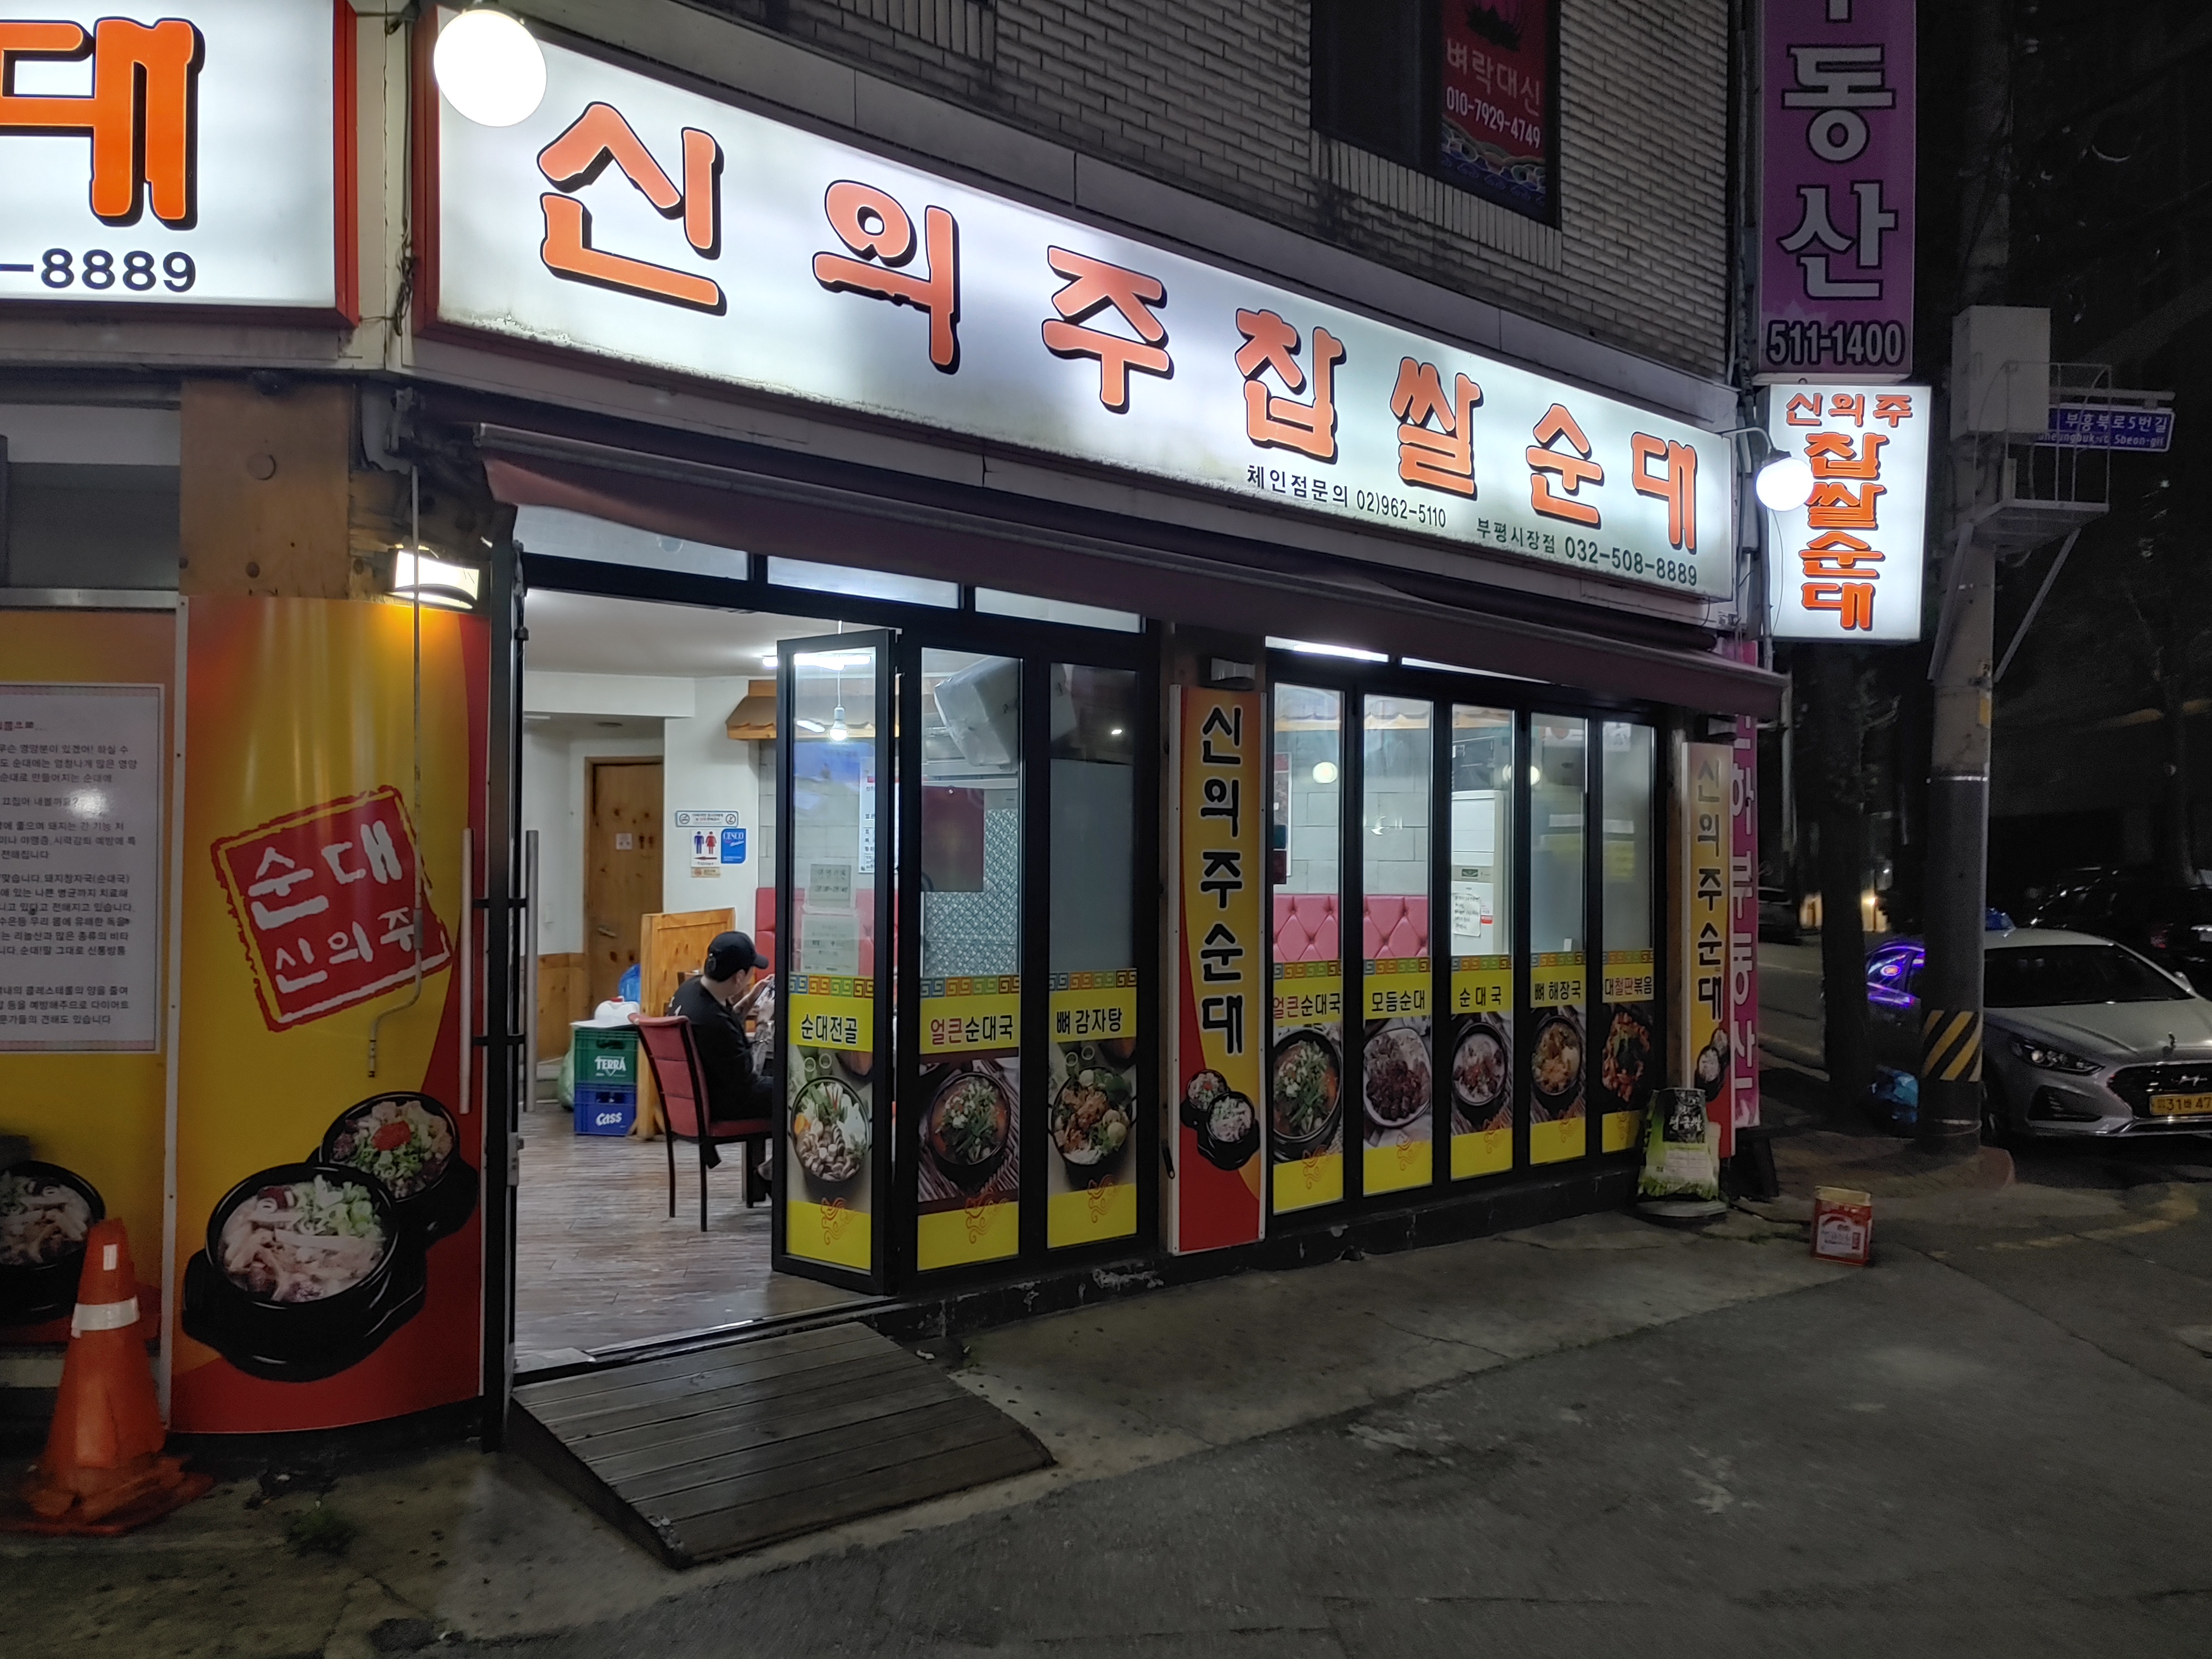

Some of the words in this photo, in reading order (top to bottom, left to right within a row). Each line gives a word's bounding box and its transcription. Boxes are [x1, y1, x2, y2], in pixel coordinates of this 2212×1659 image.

[1446, 86, 1541, 149] 010-7929-4749
[1776, 0, 1899, 301] 동산
[1766, 320, 1904, 366] 511-1400
[1786, 392, 1914, 427] 신의주
[2066, 413, 2168, 433] 부흥북로5번길
[1247, 464, 1348, 508] 체인점문의
[1356, 489, 1447, 529] 02)962-5110
[1798, 431, 1891, 631] 찹쌀순대
[1476, 517, 1556, 555] 부평시장점
[1564, 535, 1697, 587] 032-508-8889
[120, 745, 128, 754] 수
[93, 822, 111, 832] 기능
[247, 820, 403, 930] 순대
[1199, 706, 1244, 1056] 신의주순대
[1697, 758, 1723, 1022] 신의주순대
[13, 888, 32, 898] 있는
[100, 888, 128, 898] 치료해
[53, 902, 91, 912] 전해지고
[31, 917, 49, 927] 우리
[75, 917, 104, 927] 유해한
[56, 946, 84, 956] 그대로
[275, 906, 417, 994] 신의주
[1273, 992, 1341, 1019] 얼큰순대국
[1371, 989, 1425, 1013] 모듬순대
[1459, 986, 1502, 1007] 순대국
[72, 1015, 111, 1024] 있습니다
[801, 1013, 857, 1045] 순대전골
[930, 1014, 1014, 1045] 얼큰순대국
[594, 1056, 627, 1072] TERRA
